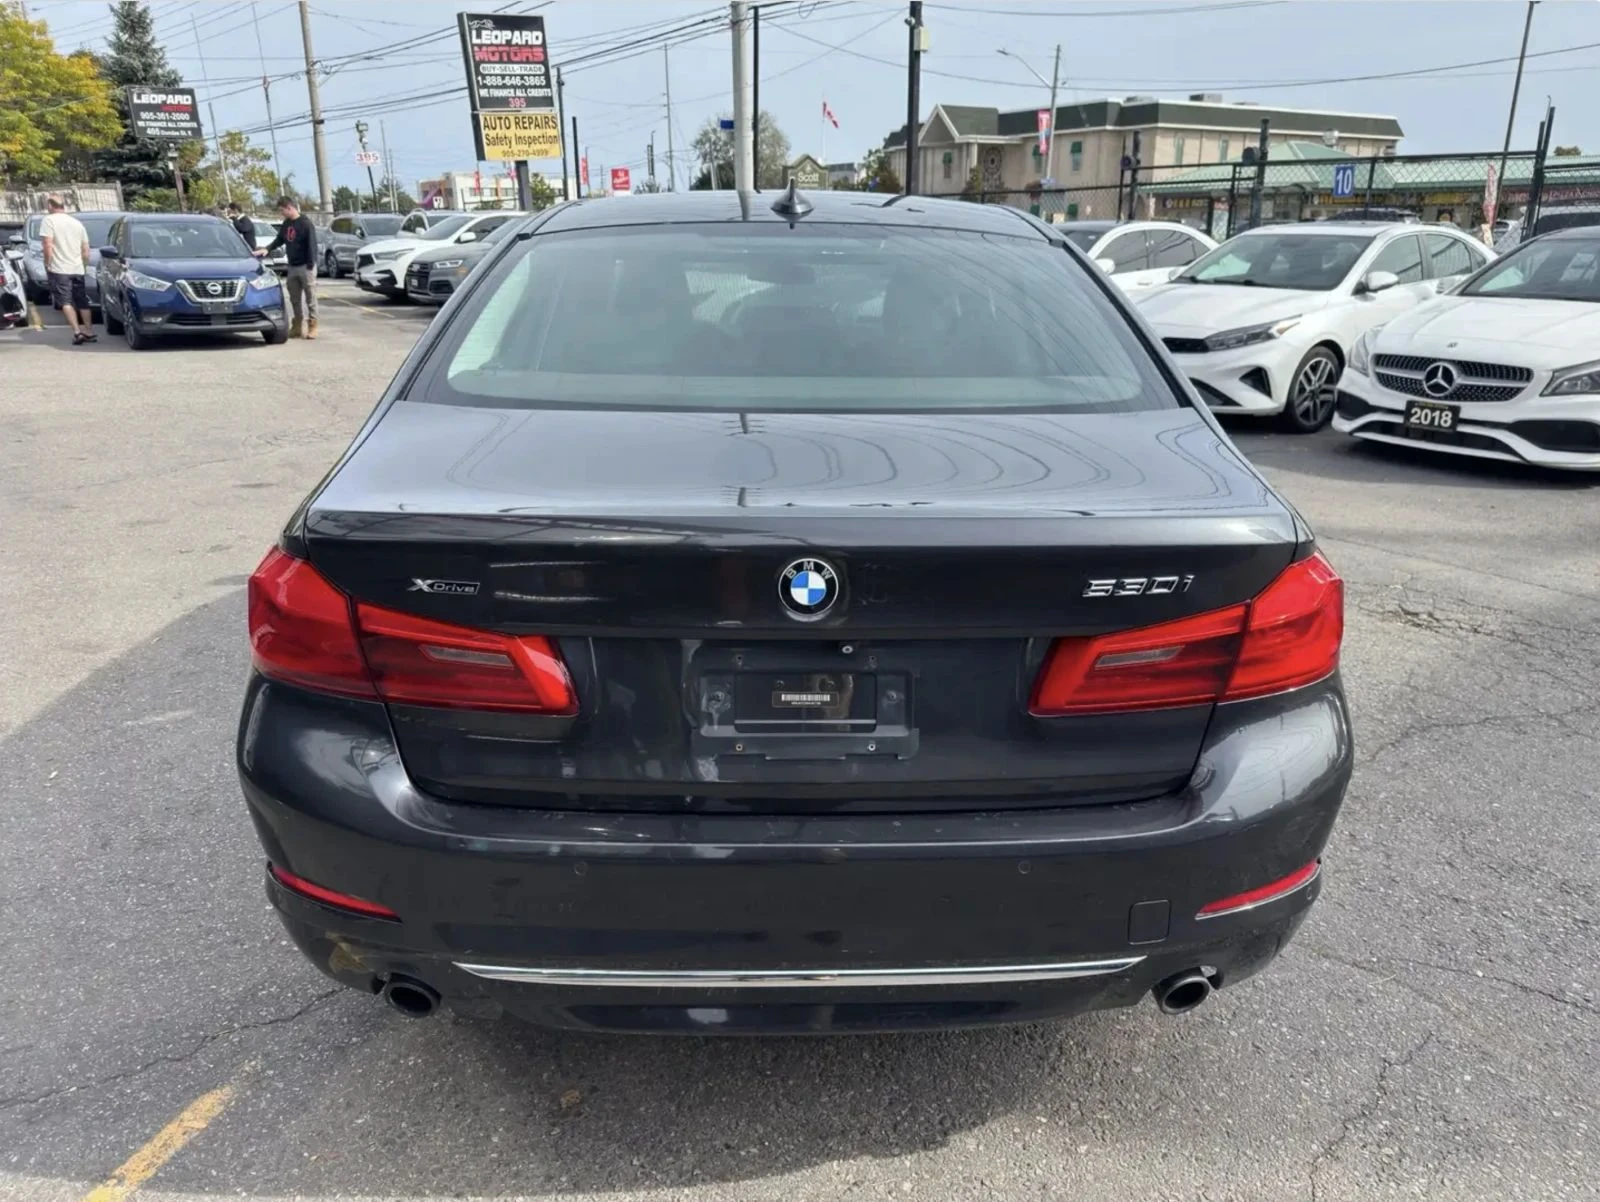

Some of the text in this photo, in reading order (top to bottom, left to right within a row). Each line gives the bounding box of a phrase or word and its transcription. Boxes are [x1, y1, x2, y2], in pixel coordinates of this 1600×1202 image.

[471, 30, 543, 45] LEOPARD
[473, 46, 544, 62] MOTORS
[133, 94, 192, 104] LEOPARD
[508, 98, 527, 107] 395
[483, 116, 558, 130] AUTO REPAIRS
[485, 133, 559, 148] Safety Inspection
[797, 171, 820, 183] Scott
[1336, 169, 1352, 194] 10
[1409, 407, 1453, 428] 2018
[785, 560, 832, 580] BMW
[1082, 575, 1195, 598] 530i
